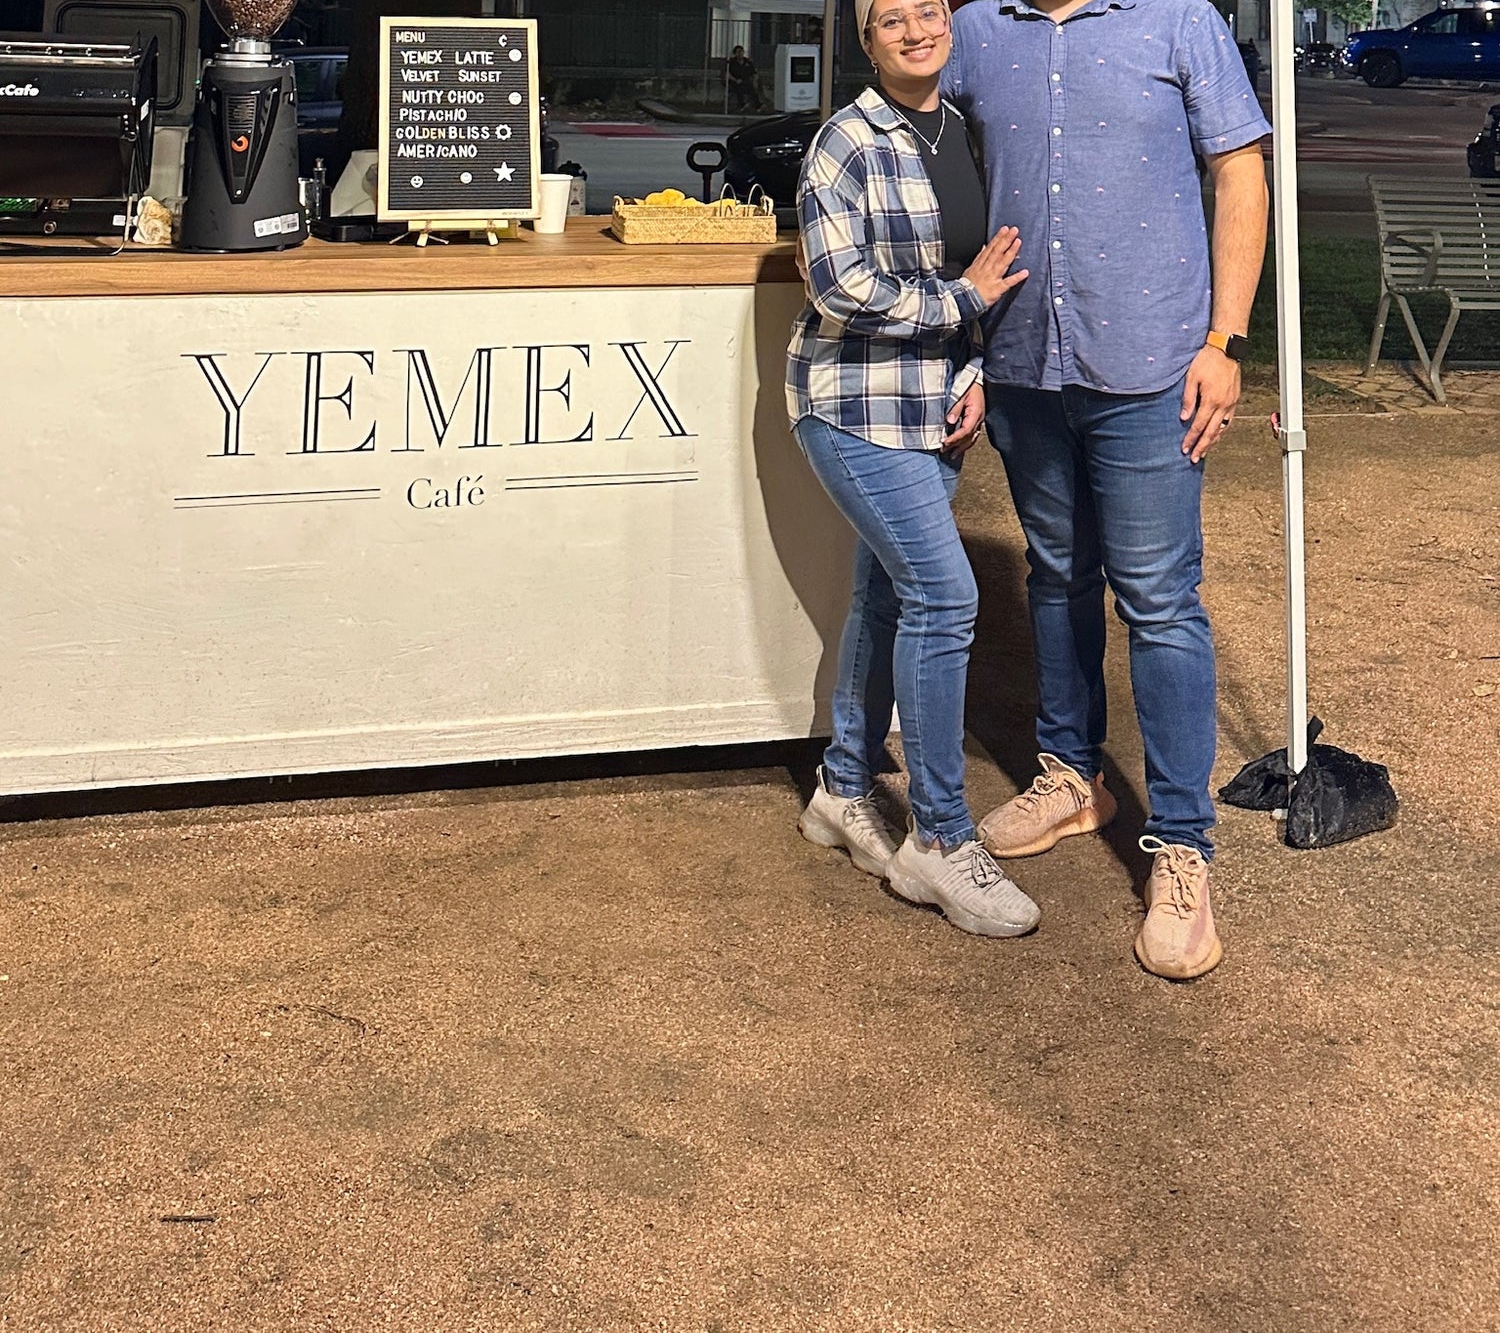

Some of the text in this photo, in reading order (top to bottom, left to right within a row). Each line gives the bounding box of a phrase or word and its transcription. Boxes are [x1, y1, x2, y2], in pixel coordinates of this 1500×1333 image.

[396, 31, 426, 44] MENU
[400, 50, 495, 65] YEMEX LATTE
[401, 68, 502, 82] VELVET SUNSET
[402, 90, 485, 104] NUTTY CHOC
[399, 108, 468, 122] PISTACHIO
[395, 125, 491, 139] GOLDEN BLISS
[397, 143, 479, 158] AMERICANO
[180, 340, 699, 458] YEMEX
[406, 475, 486, 510] Café
